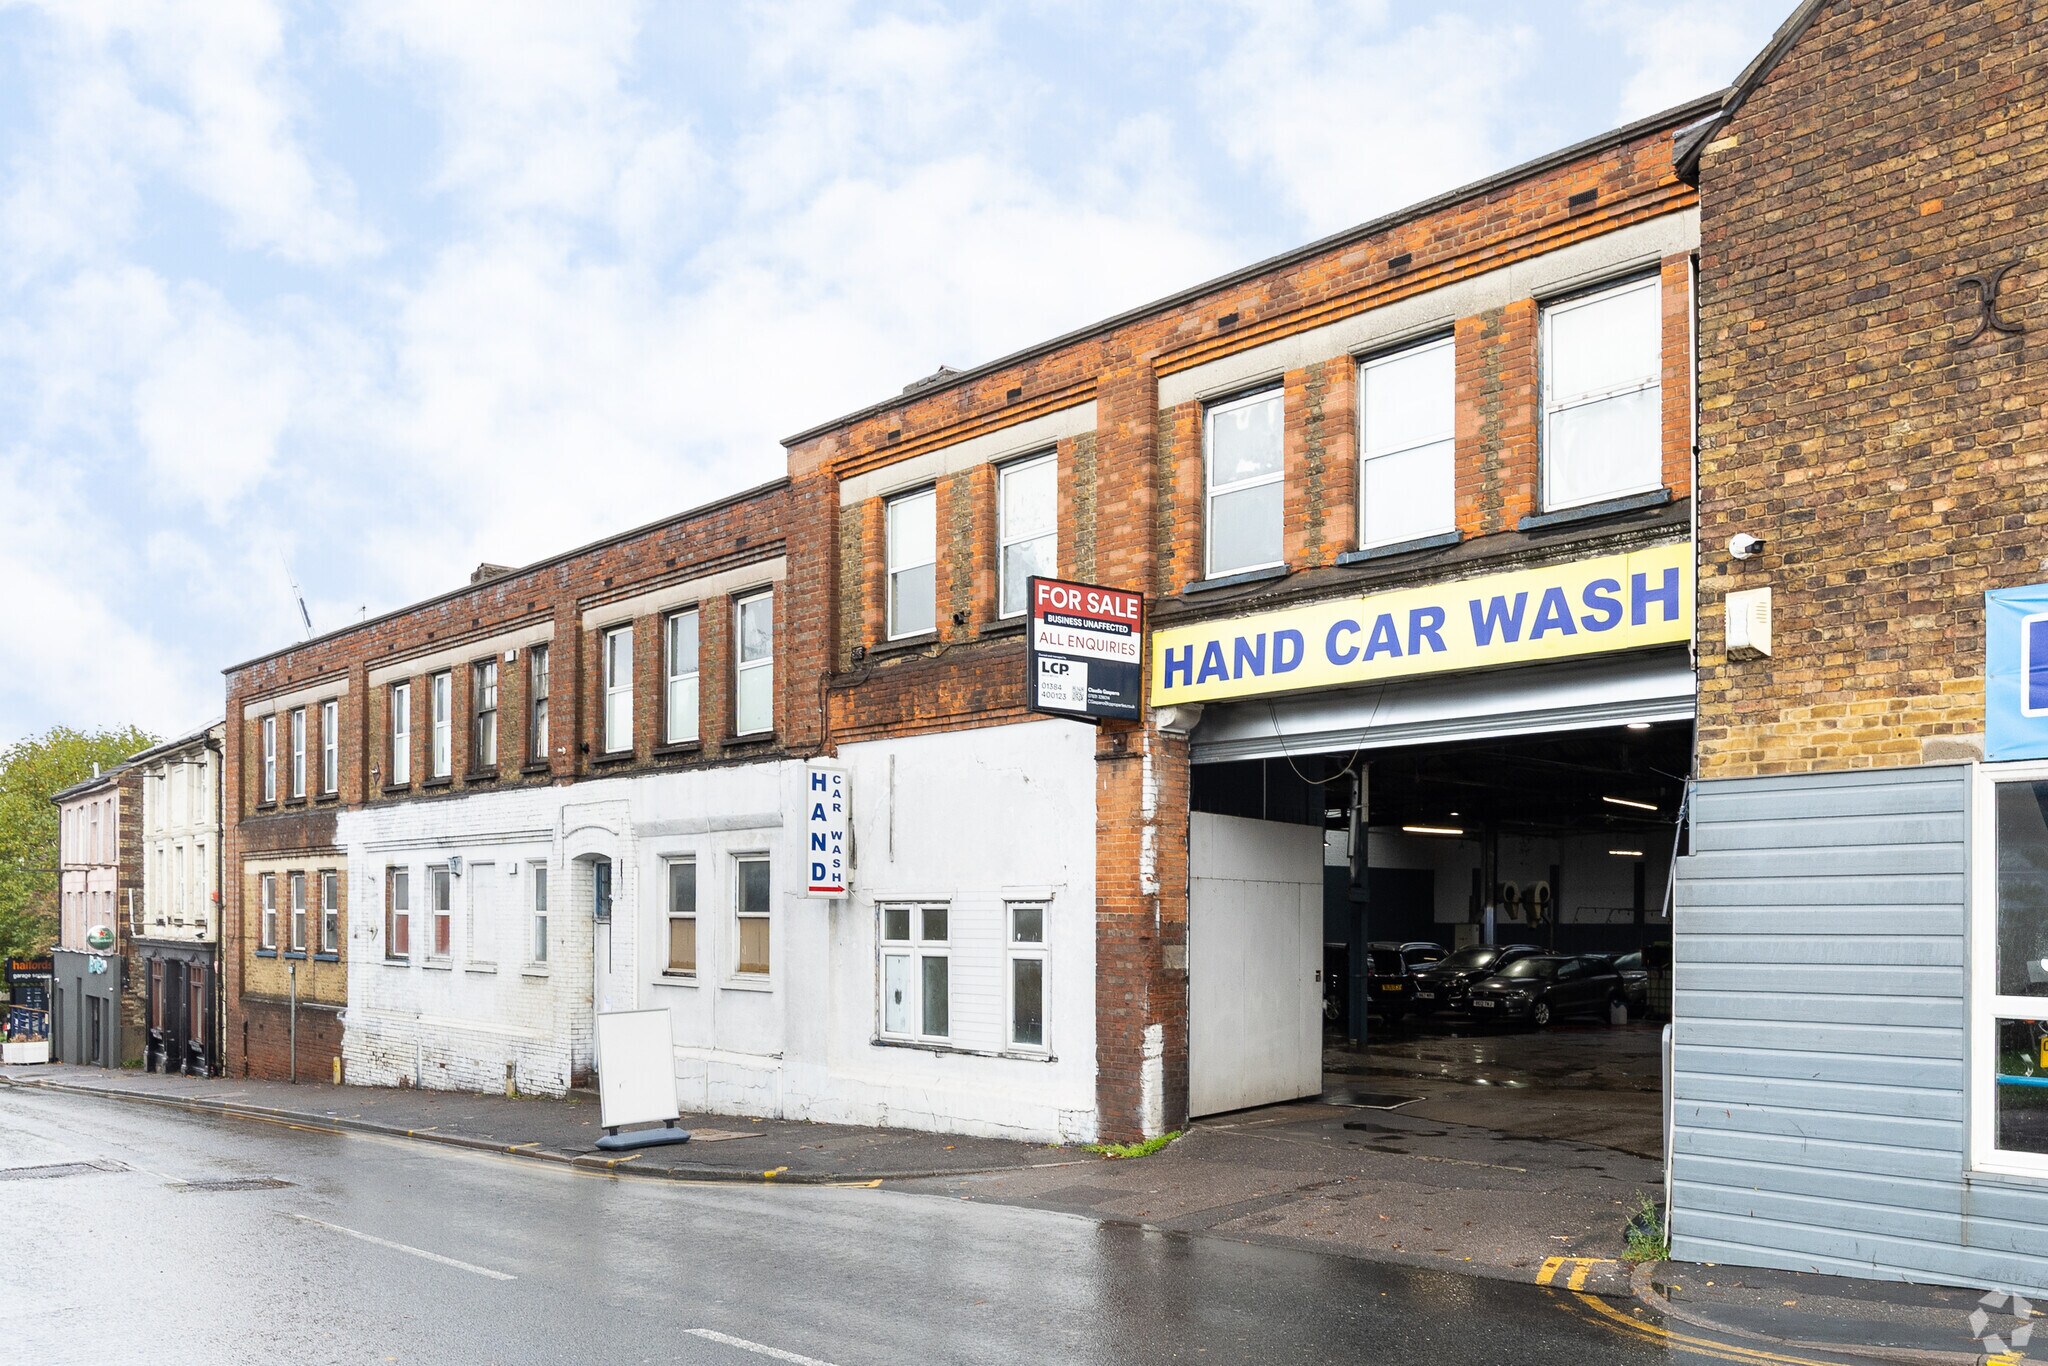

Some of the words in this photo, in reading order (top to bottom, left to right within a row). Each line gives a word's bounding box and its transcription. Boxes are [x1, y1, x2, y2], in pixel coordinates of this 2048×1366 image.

[1038, 584, 1082, 611] FOR
[1086, 592, 1138, 619] SALE
[1047, 614, 1083, 627] BUSINESS
[1083, 619, 1129, 634] UNAFFECTED
[1163, 627, 1304, 689] HAND
[1325, 606, 1447, 665] CAR
[1469, 566, 1680, 647] WASH
[1039, 631, 1064, 646] ALL
[1068, 635, 1136, 656] ENQUIRIES
[1041, 682, 1062, 691] 01384
[1041, 690, 1067, 701] 400123
[832, 775, 842, 812] CAR
[811, 772, 827, 881] HAND
[830, 831, 843, 882] WASH
